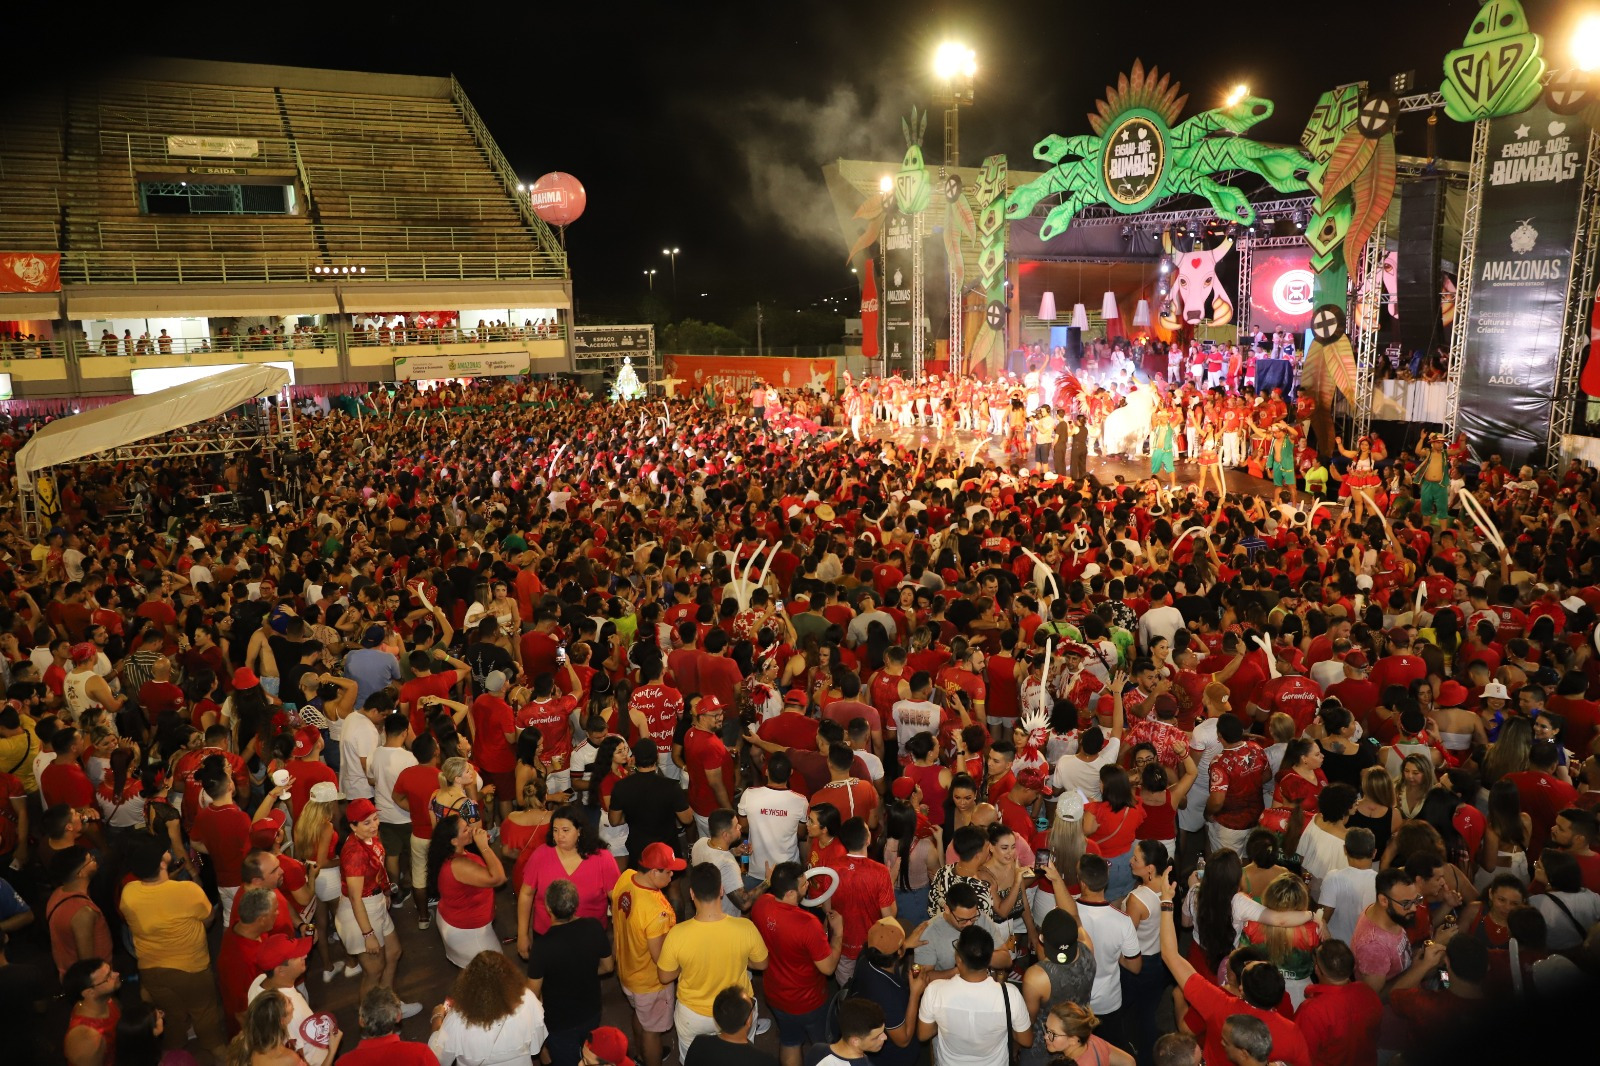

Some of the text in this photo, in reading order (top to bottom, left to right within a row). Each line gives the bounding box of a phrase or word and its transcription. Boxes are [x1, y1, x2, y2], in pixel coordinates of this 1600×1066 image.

[1501, 137, 1571, 158] ENSAIO DOS
[1481, 259, 1561, 281] AMAZONAS
[1478, 318, 1505, 326] Cultura
[1477, 325, 1505, 334] Criativa
[1281, 691, 1315, 702] Garantido
[529, 715, 561, 727] Garantido
